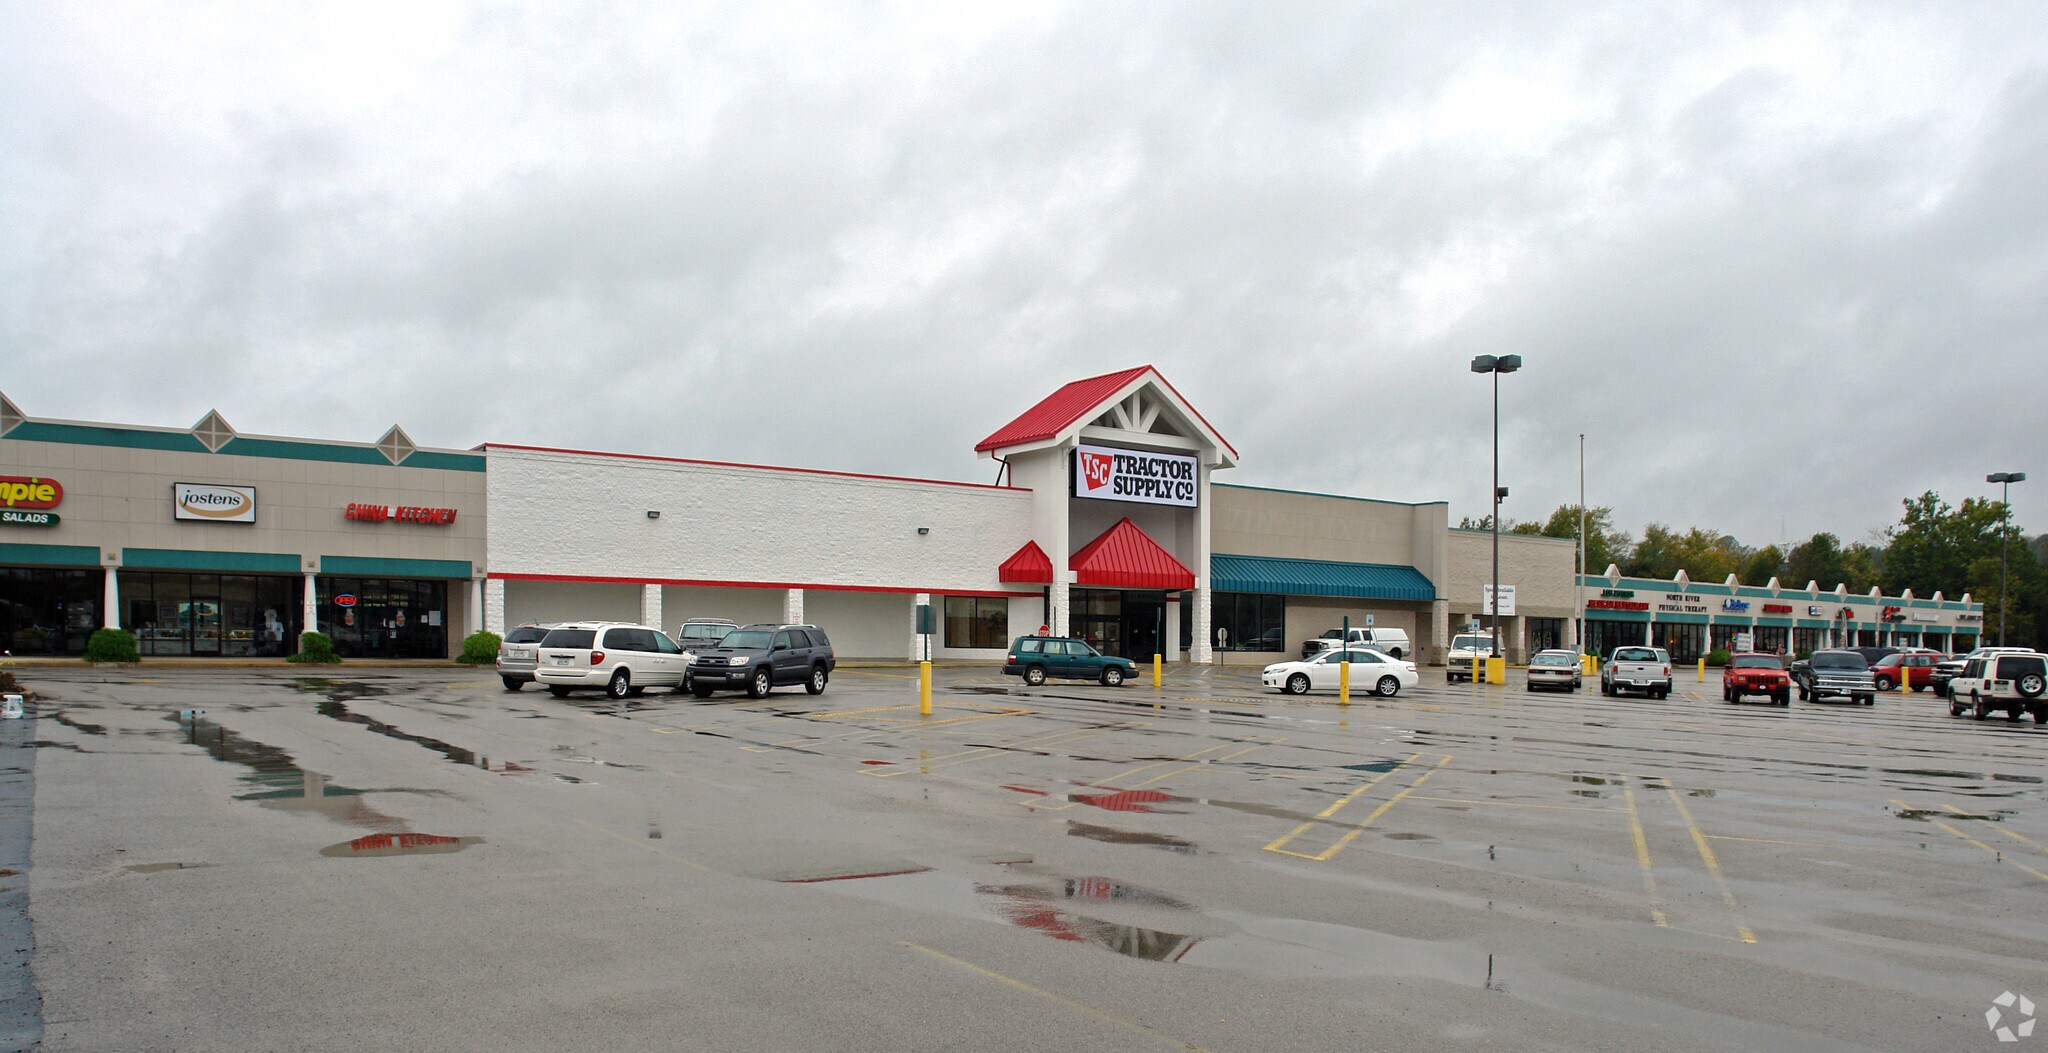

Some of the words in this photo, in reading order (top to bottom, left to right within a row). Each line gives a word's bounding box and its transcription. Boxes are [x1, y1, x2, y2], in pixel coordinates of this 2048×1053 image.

[1083, 453, 1108, 484] TSC
[1113, 454, 1193, 480] TRACTOR
[1113, 475, 1174, 499] SUPPLY
[183, 490, 241, 506] jostens
[2, 512, 49, 523] SALADS
[345, 503, 388, 521] CHINA
[394, 507, 458, 524] KITCHEN
[334, 595, 357, 606] OPEN
[1666, 594, 1683, 602] NORTH
[1658, 604, 1683, 612] PHYSICAL
[1684, 605, 1708, 613] THERAPY
